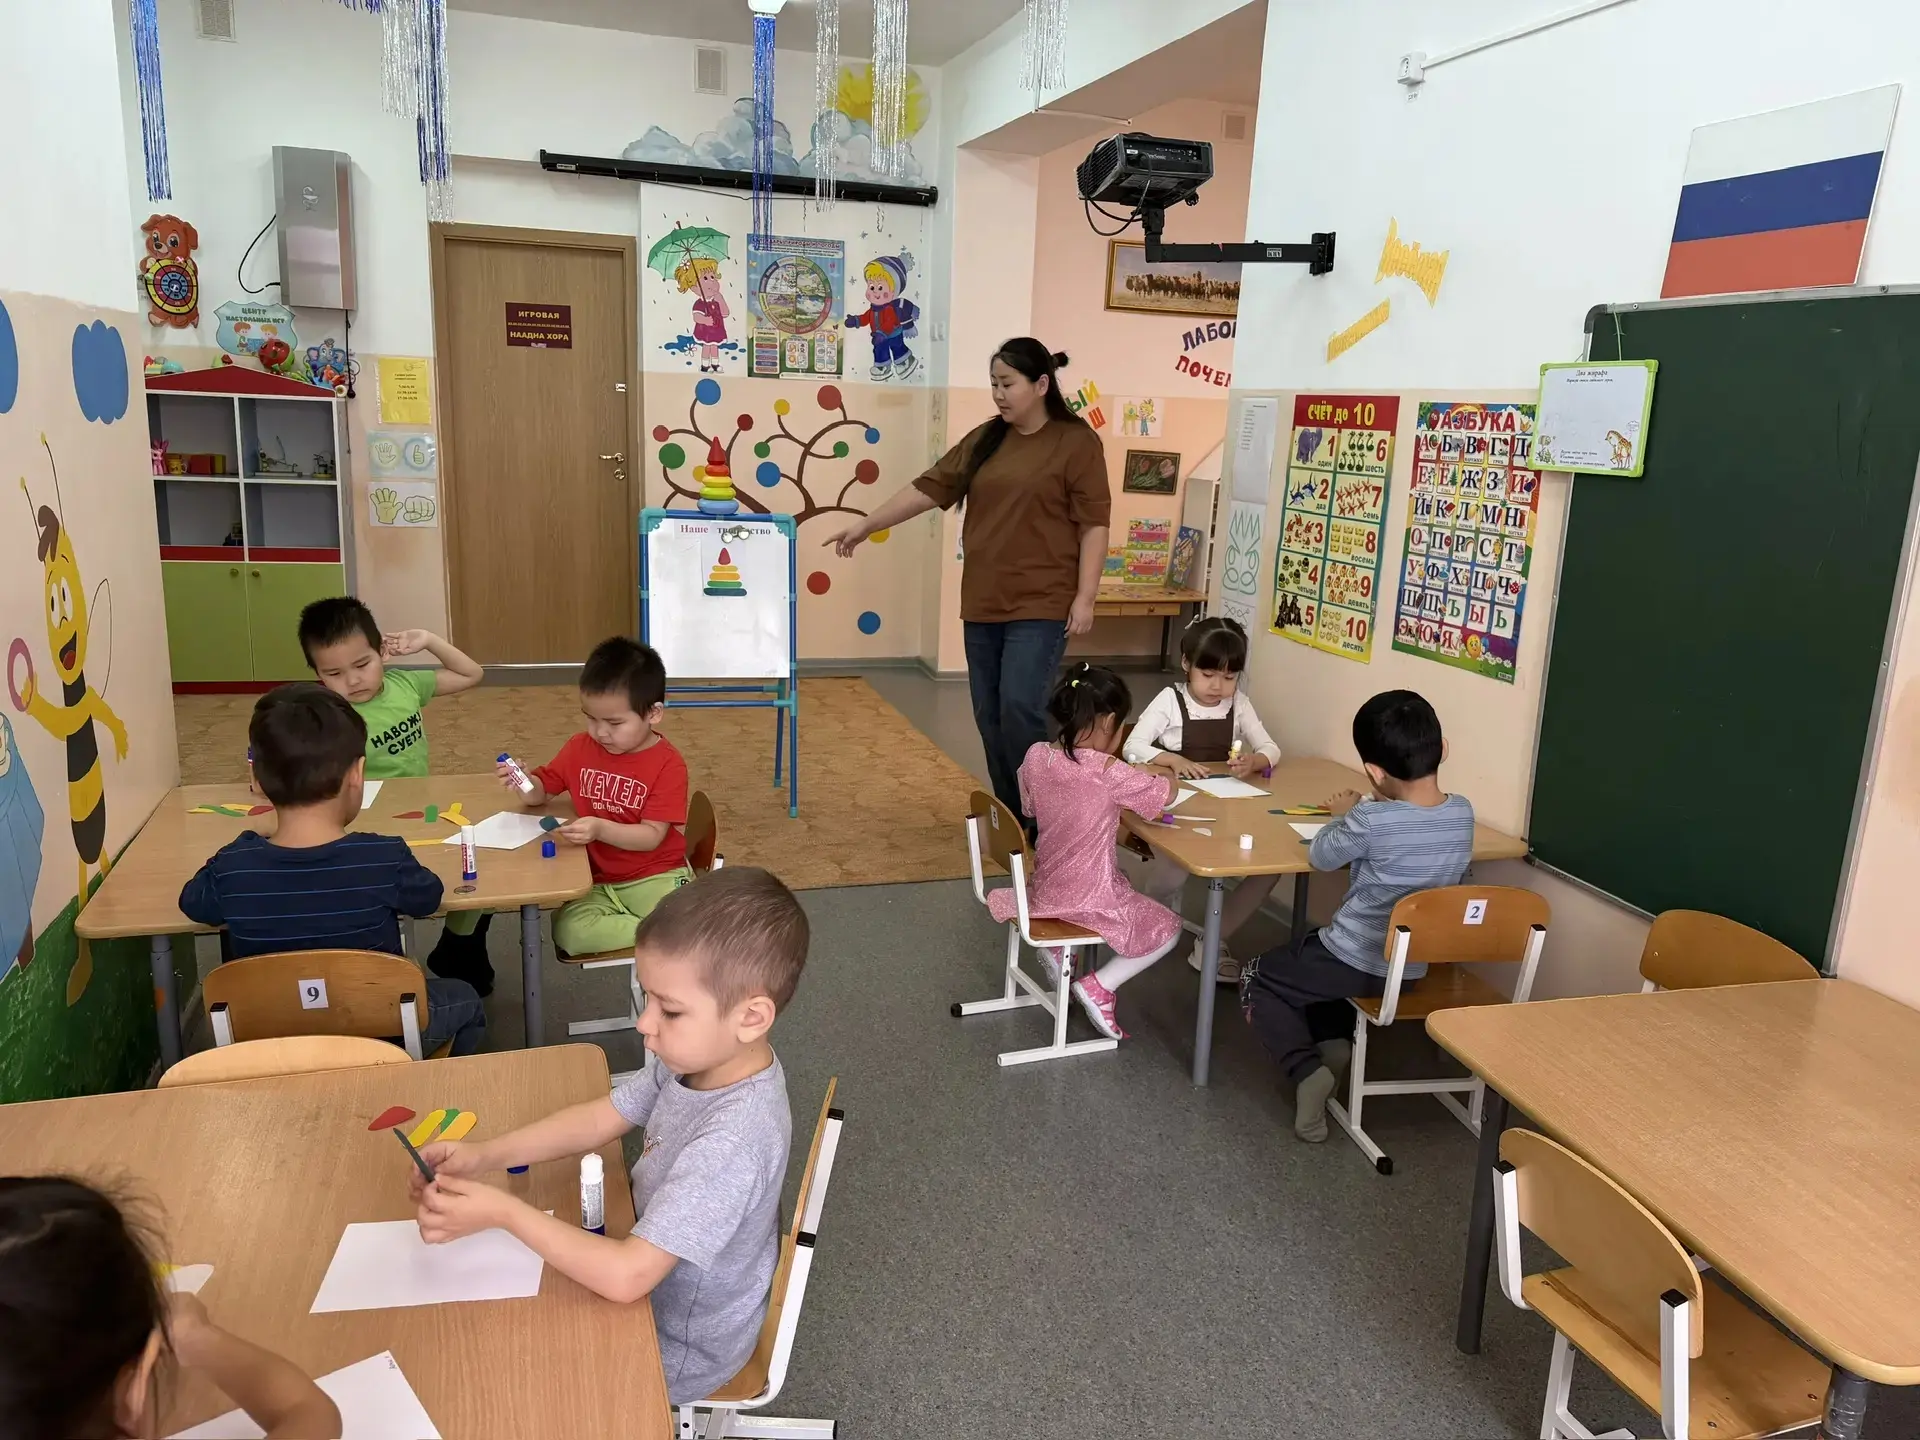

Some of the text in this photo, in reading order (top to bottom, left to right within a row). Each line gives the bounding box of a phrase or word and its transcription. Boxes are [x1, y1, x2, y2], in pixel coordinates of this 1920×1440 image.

[518, 311, 560, 319] ИГРОВАЯ
[510, 331, 569, 341] НААДНА ХОРА
[1308, 401, 1332, 420] СЧЁТ
[1354, 402, 1375, 426] 10
[1440, 410, 1516, 432] АЗБУКА
[1328, 435, 1335, 456] 1
[1376, 439, 1387, 461] 6
[1420, 434, 1430, 452] А
[1442, 435, 1452, 452] Б
[1466, 436, 1476, 454] В
[1490, 438, 1501, 455] Г
[1513, 438, 1528, 458] Д
[1318, 460, 1332, 468] один
[1365, 464, 1384, 473] шесть
[1418, 466, 1428, 484] Е
[1440, 463, 1450, 486] Ё
[1461, 470, 1479, 488] Ж
[1487, 472, 1498, 490] З
[1512, 474, 1528, 494] И
[1319, 479, 1329, 500] 2
[1372, 486, 1382, 508] 7
[1316, 503, 1327, 511] два
[1414, 493, 1427, 516] Й
[1435, 500, 1447, 518] К
[1456, 502, 1470, 520] Л
[1480, 504, 1497, 524] М
[1363, 511, 1379, 520] семь
[1504, 507, 1520, 527] Н
[680, 525, 771, 535] Наше твоство
[1314, 522, 1323, 543] 3
[1411, 528, 1422, 546] О
[1312, 546, 1322, 554] три
[1366, 531, 1376, 553] 8
[1431, 532, 1445, 550] П
[1454, 534, 1465, 552] Р
[1480, 538, 1492, 557] С
[1351, 555, 1374, 564] восемь
[1505, 542, 1517, 562] Т
[1308, 565, 1318, 585] 4
[1408, 559, 1419, 576] У
[1427, 563, 1440, 580] Ф
[1449, 567, 1463, 586] Х
[1297, 586, 1317, 596] четыре
[1361, 576, 1371, 597] 9
[1473, 571, 1487, 593] Ц
[1498, 576, 1512, 596] Ч
[1348, 599, 1369, 609] девять
[1402, 588, 1417, 608] Ш
[1423, 592, 1439, 616] Щ
[1305, 606, 1315, 625] 5
[1448, 598, 1460, 618] Ъ
[1469, 604, 1486, 625] Ы
[1399, 618, 1409, 636] Э
[1495, 609, 1507, 628] Ь
[1300, 627, 1312, 636] пять
[1346, 617, 1367, 642] 10
[1416, 623, 1433, 643] Ю
[1342, 642, 1364, 652] десять
[1441, 630, 1454, 650] Я
[388, 725, 422, 755] СУЕТУ
[580, 768, 647, 809] NEVER
[1470, 906, 1480, 918] 2
[307, 986, 319, 1002] 9
